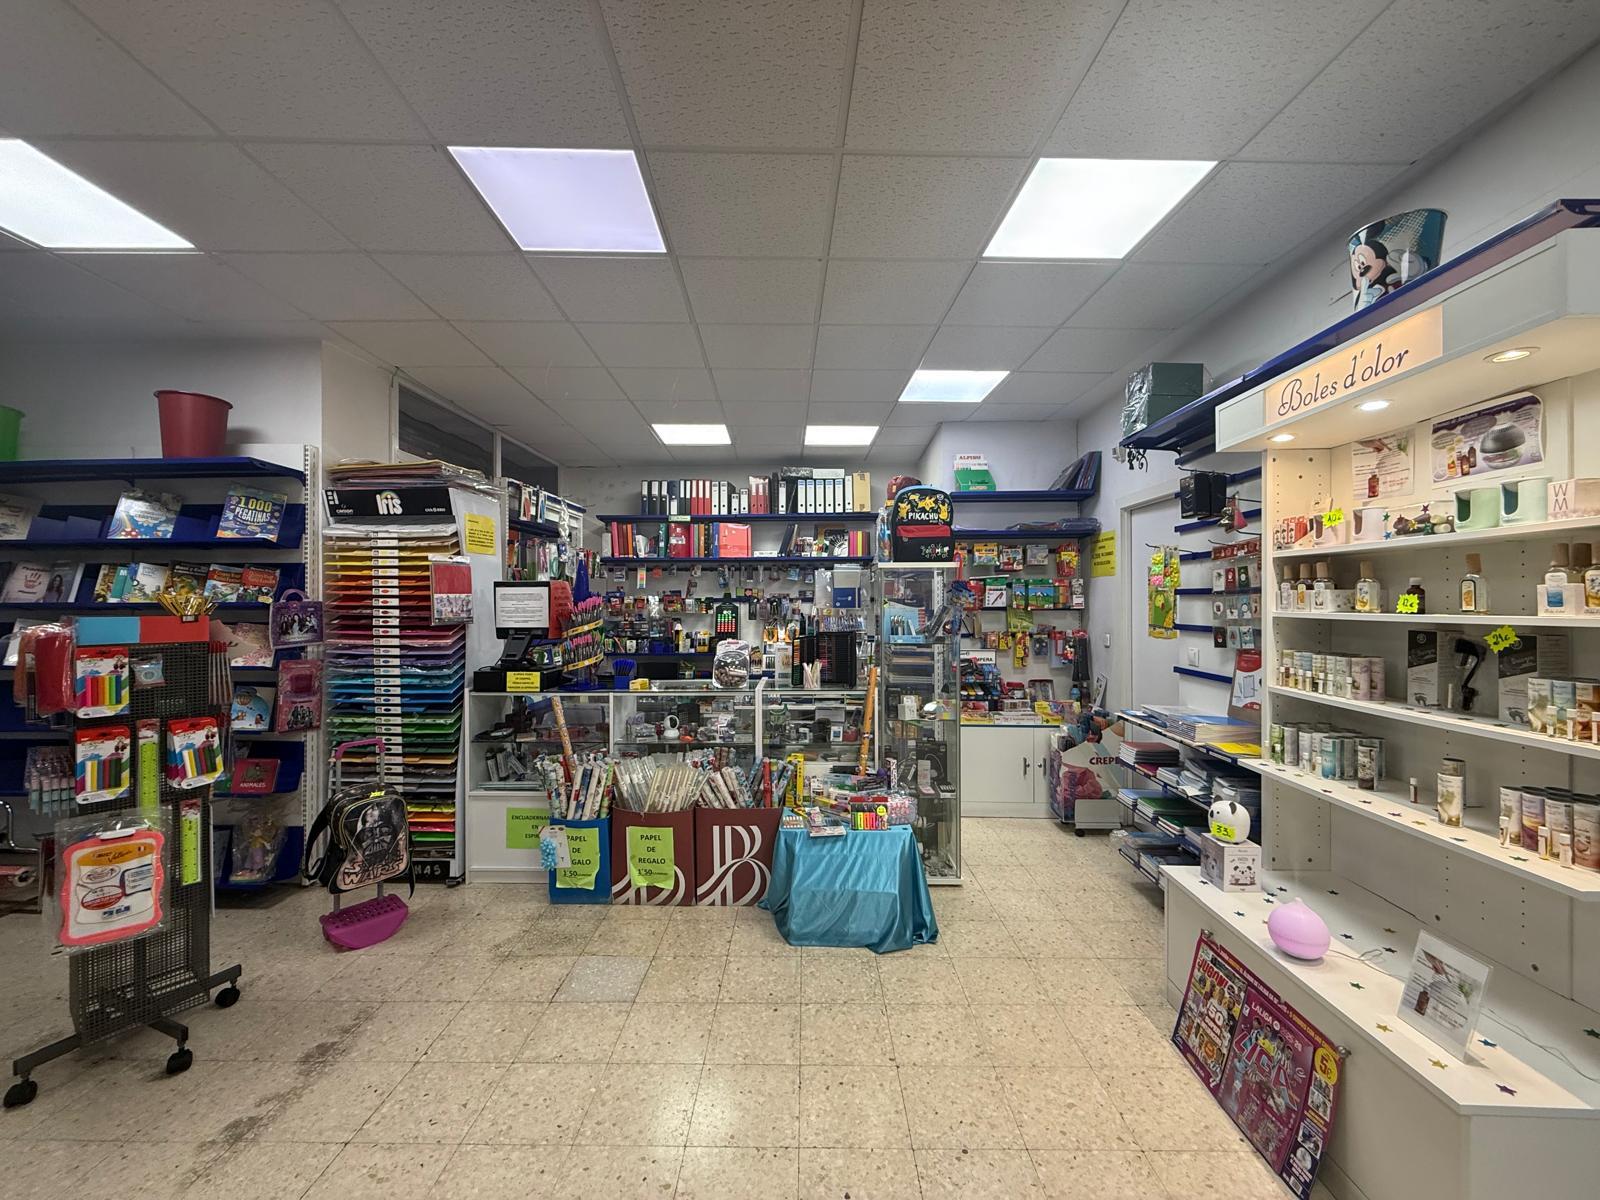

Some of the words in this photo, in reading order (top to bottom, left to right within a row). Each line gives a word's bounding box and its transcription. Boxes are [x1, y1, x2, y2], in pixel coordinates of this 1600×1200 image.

[1277, 372, 1338, 417] Boles
[1343, 343, 1409, 390] d'olor
[376, 493, 403, 515] Iris
[234, 506, 271, 523] PEGATINAS
[908, 512, 939, 521] PIKACHU
[638, 857, 666, 865] REGALO
